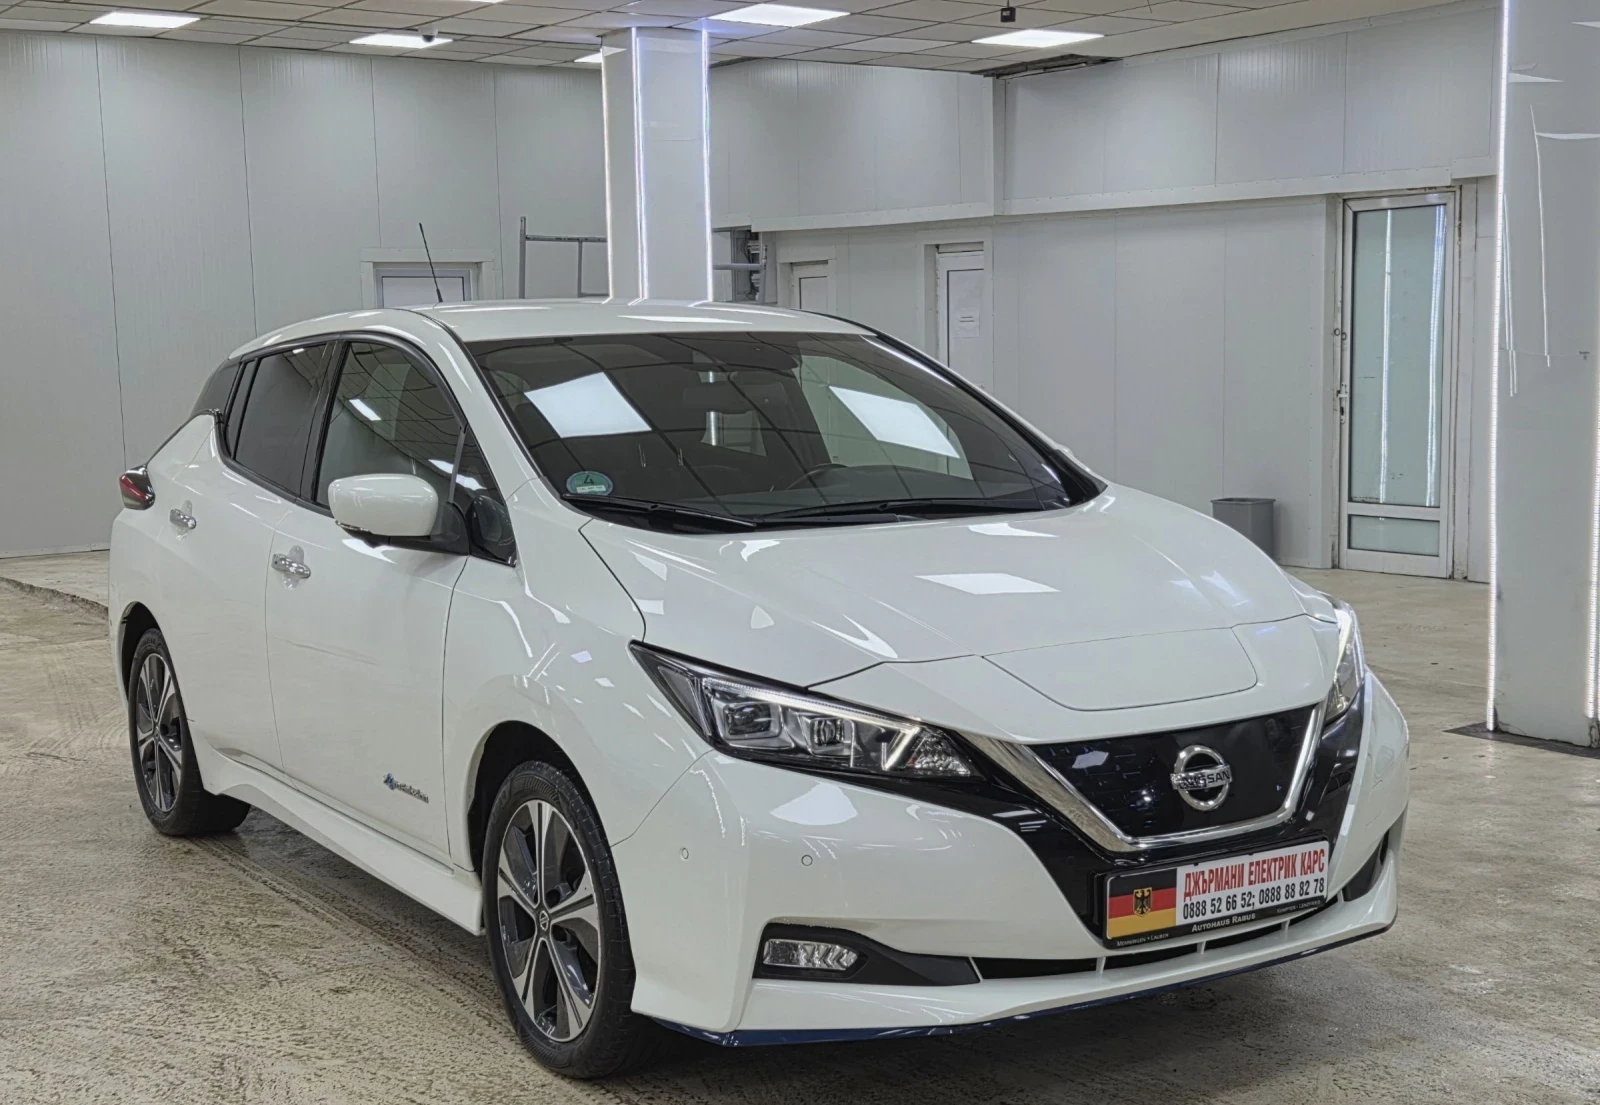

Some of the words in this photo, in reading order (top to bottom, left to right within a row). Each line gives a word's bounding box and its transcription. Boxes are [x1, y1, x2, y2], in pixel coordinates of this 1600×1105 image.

[1183, 900, 1206, 919] 0888
[1210, 897, 1222, 914] 52
[1226, 894, 1237, 911] 66
[1241, 891, 1255, 909] 52;
[1259, 885, 1281, 905] 0888
[1285, 883, 1296, 900] 88
[1299, 880, 1310, 897] 82
[1314, 877, 1325, 893] 78
[1184, 863, 1244, 902] ДЖЪРМАНИ
[1248, 853, 1297, 886] ЕЛЕКТРИК
[1300, 848, 1325, 876] КАРС
